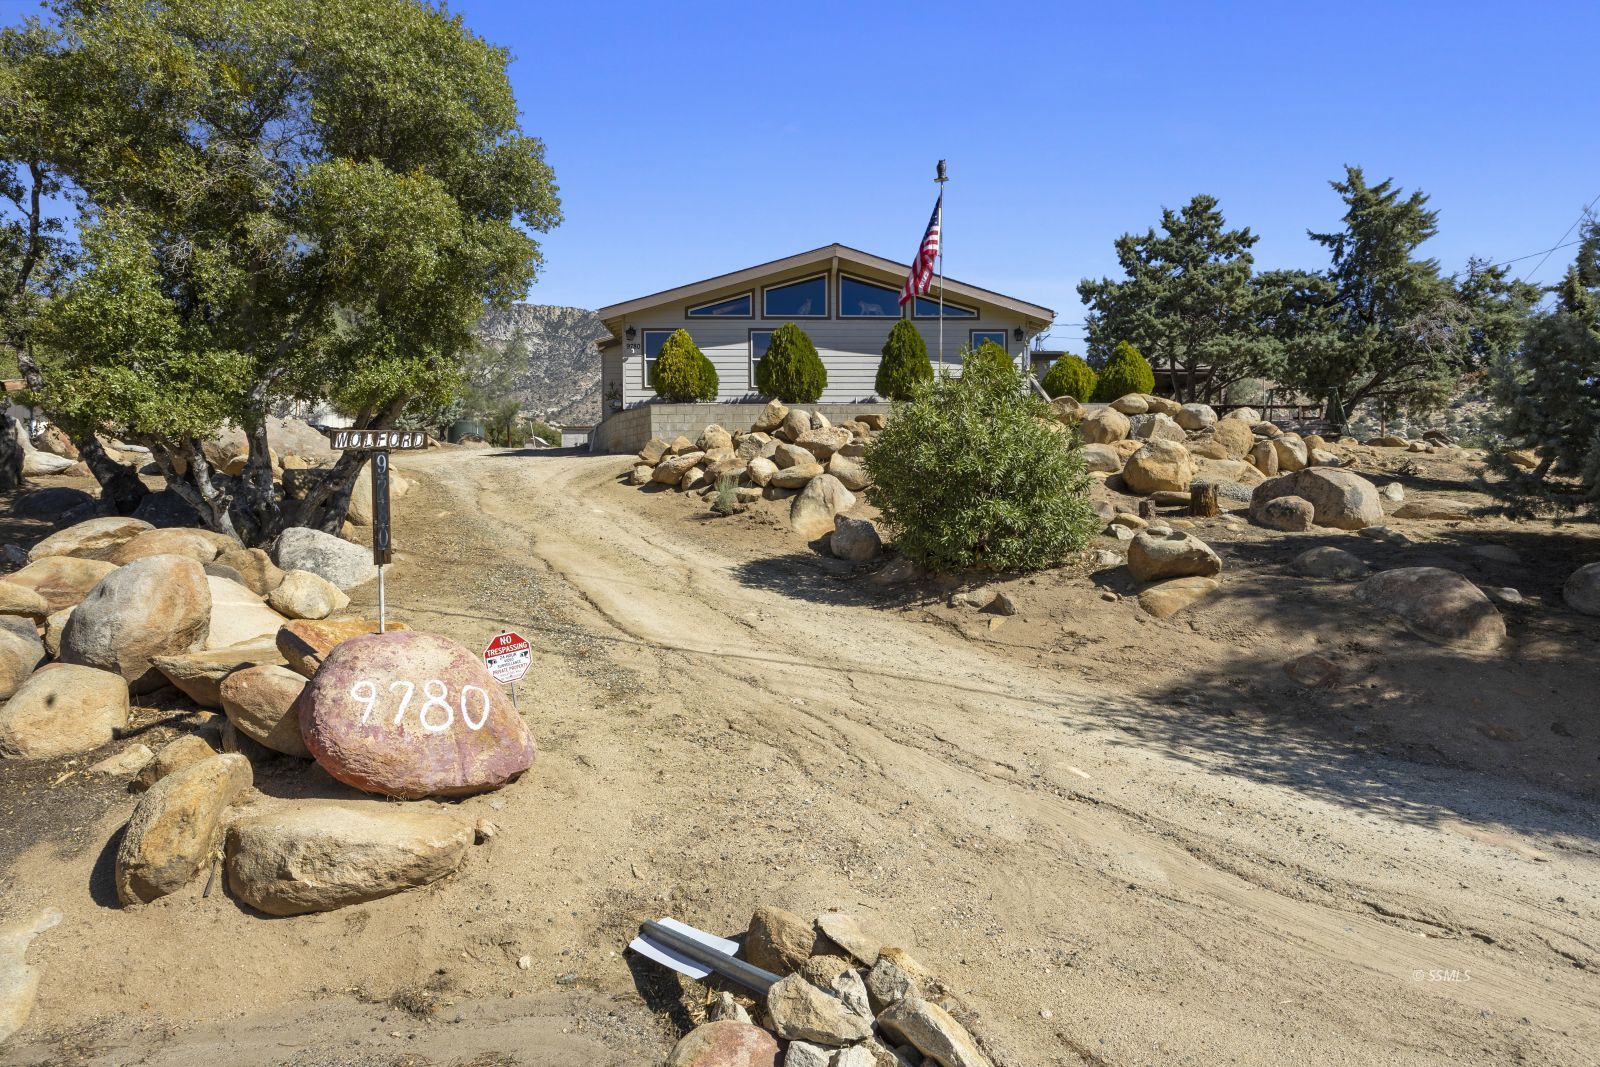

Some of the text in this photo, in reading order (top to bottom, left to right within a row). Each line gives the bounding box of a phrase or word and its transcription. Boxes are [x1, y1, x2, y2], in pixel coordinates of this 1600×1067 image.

[334, 432, 424, 449] WOLFORD
[499, 635, 512, 646] NO
[486, 641, 528, 657] TRESPASSING
[350, 679, 490, 732] 9780
